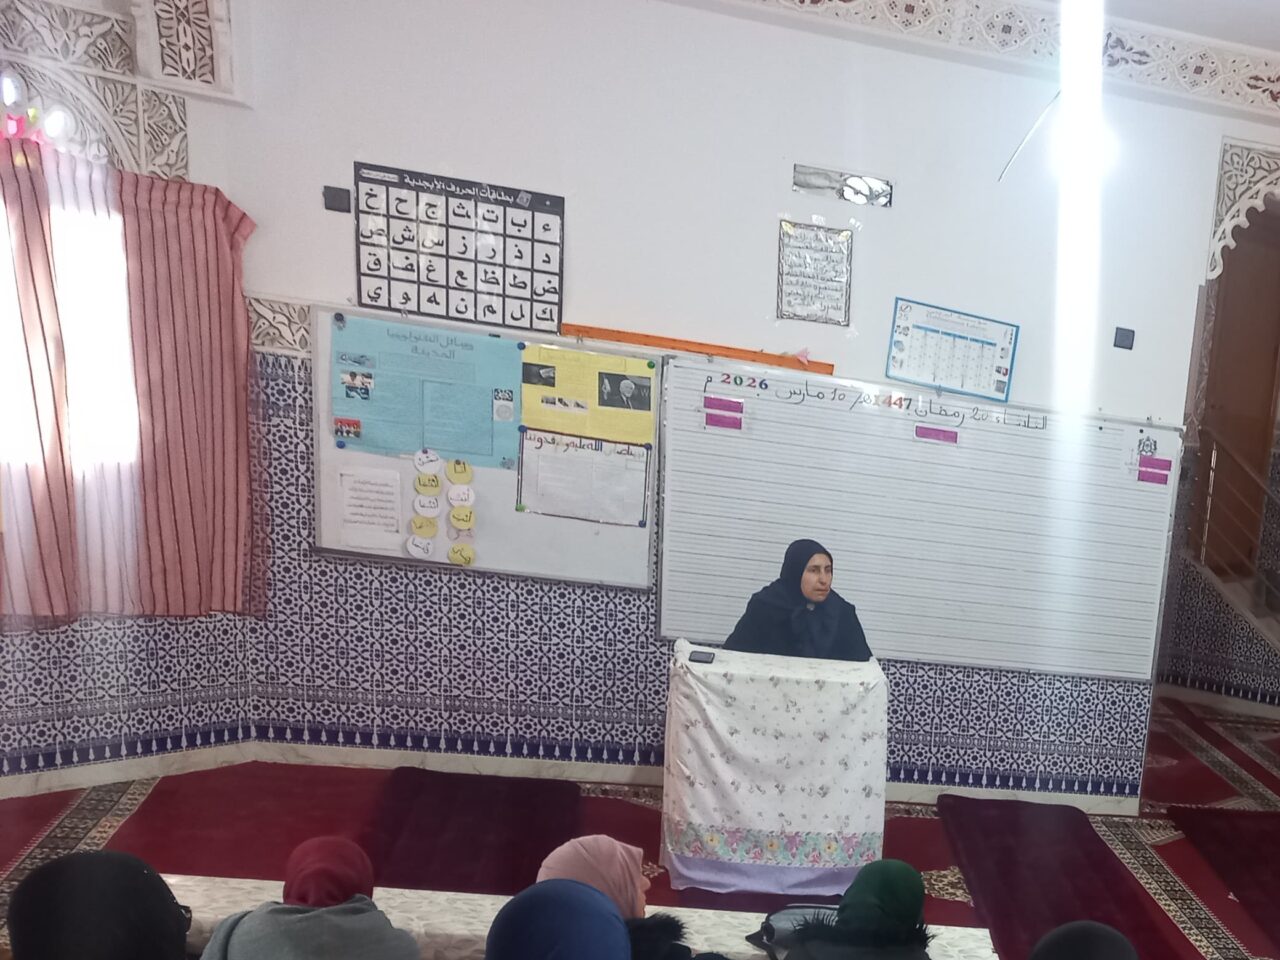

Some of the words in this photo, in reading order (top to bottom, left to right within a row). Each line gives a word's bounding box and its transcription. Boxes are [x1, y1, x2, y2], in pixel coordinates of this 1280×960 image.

[364, 187, 380, 209] خ
[394, 196, 408, 215] ح
[425, 201, 438, 220] ج
[452, 202, 471, 219] ث
[482, 209, 498, 223] ت
[360, 227, 387, 240] ص
[511, 217, 527, 233] ب
[542, 221, 551, 233] ء
[392, 224, 415, 245] ش
[422, 238, 444, 249] س
[457, 236, 468, 255] ز
[514, 244, 523, 260] ذ
[367, 252, 381, 271] ق
[486, 248, 496, 259] ر
[542, 252, 551, 264] د
[392, 255, 415, 273] ف
[426, 260, 439, 282] غ
[455, 270, 468, 287] ع
[480, 268, 500, 286] ظ
[509, 274, 527, 289] ط
[367, 286, 382, 302] ي
[533, 279, 559, 297] ض
[400, 292, 411, 305] و
[427, 292, 440, 306] ه
[455, 297, 467, 314] ن
[483, 304, 497, 317] م
[511, 304, 524, 321] ل
[536, 308, 555, 323] ك
[720, 373, 768, 390] 2026
[775, 380, 825, 404] مارس
[914, 399, 964, 427] رمضان
